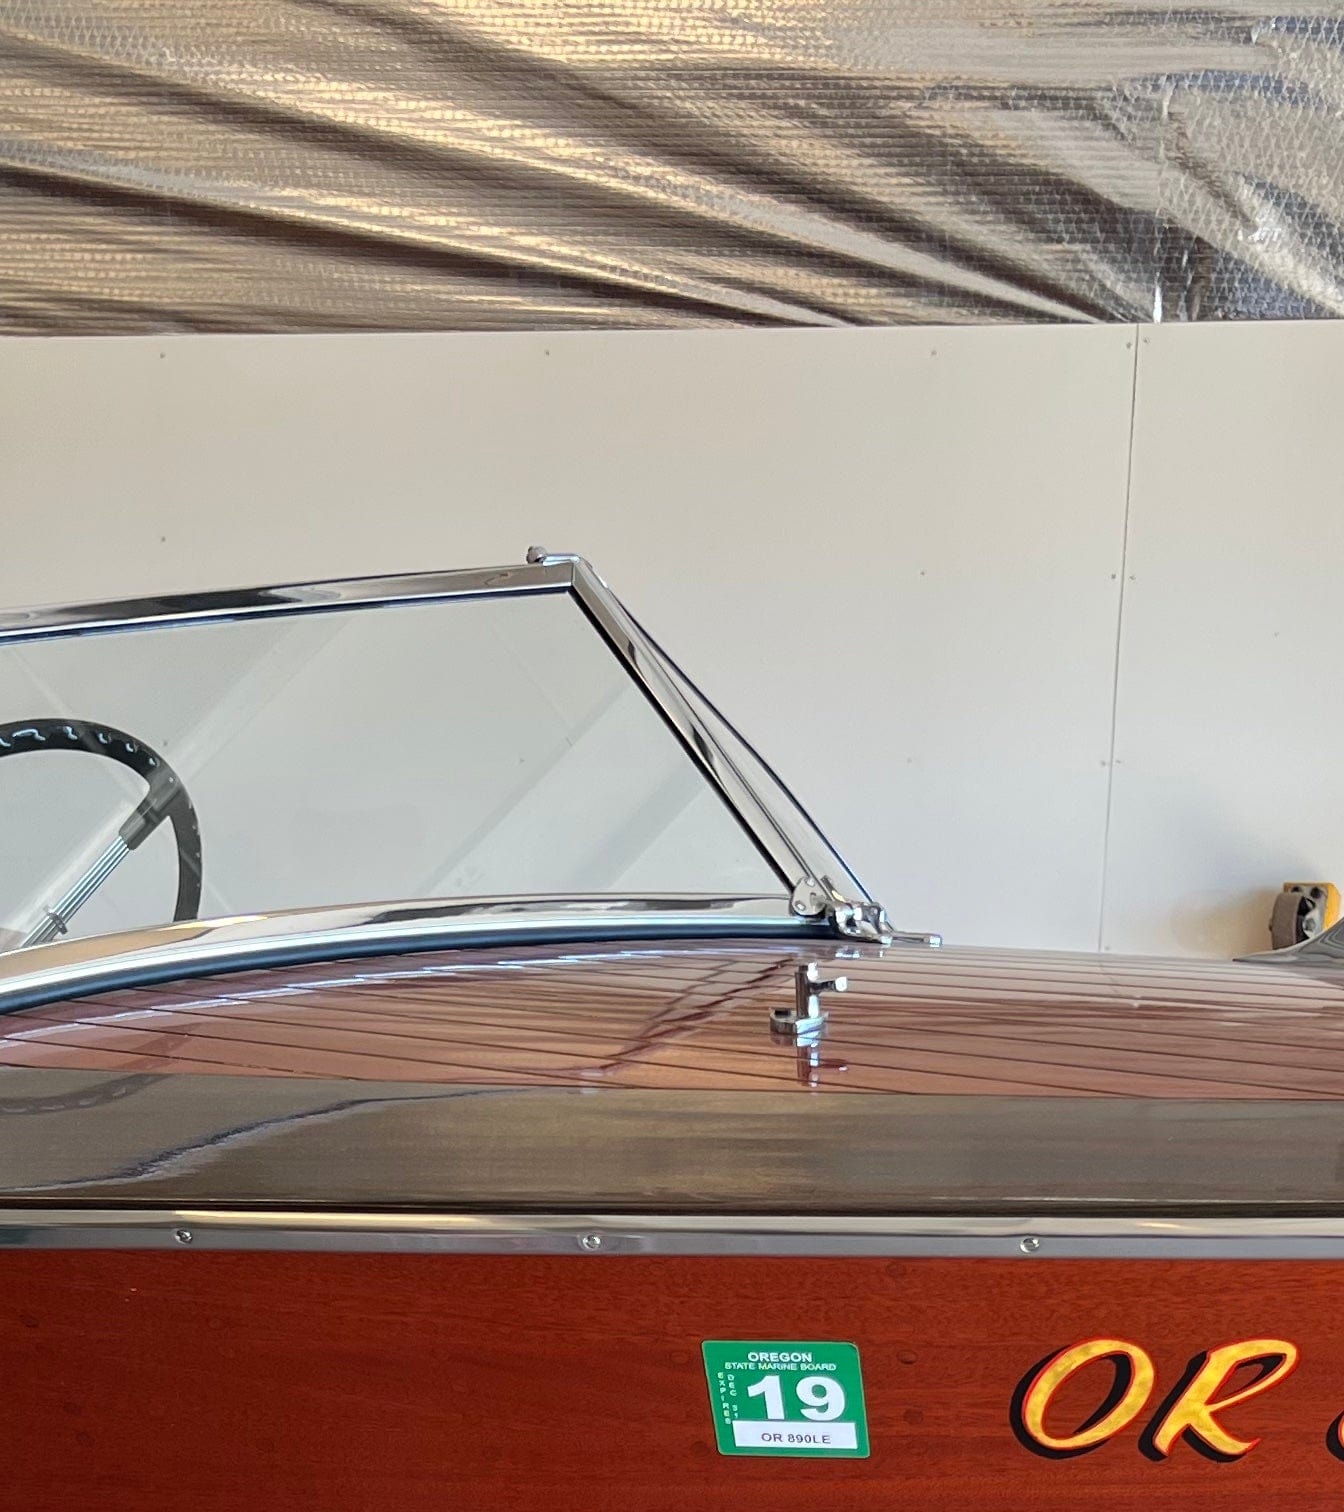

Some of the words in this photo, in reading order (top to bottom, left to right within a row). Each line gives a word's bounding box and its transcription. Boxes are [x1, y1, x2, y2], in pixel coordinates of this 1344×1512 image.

[747, 1352, 812, 1363] OREGON
[724, 1361, 756, 1371] STATE
[758, 1362, 798, 1371] MARINE
[800, 1363, 837, 1372] BOARD
[747, 1374, 845, 1422] 19
[1010, 1336, 1298, 1461] OR
[761, 1432, 783, 1443] OR
[787, 1433, 831, 1444] 890LE
